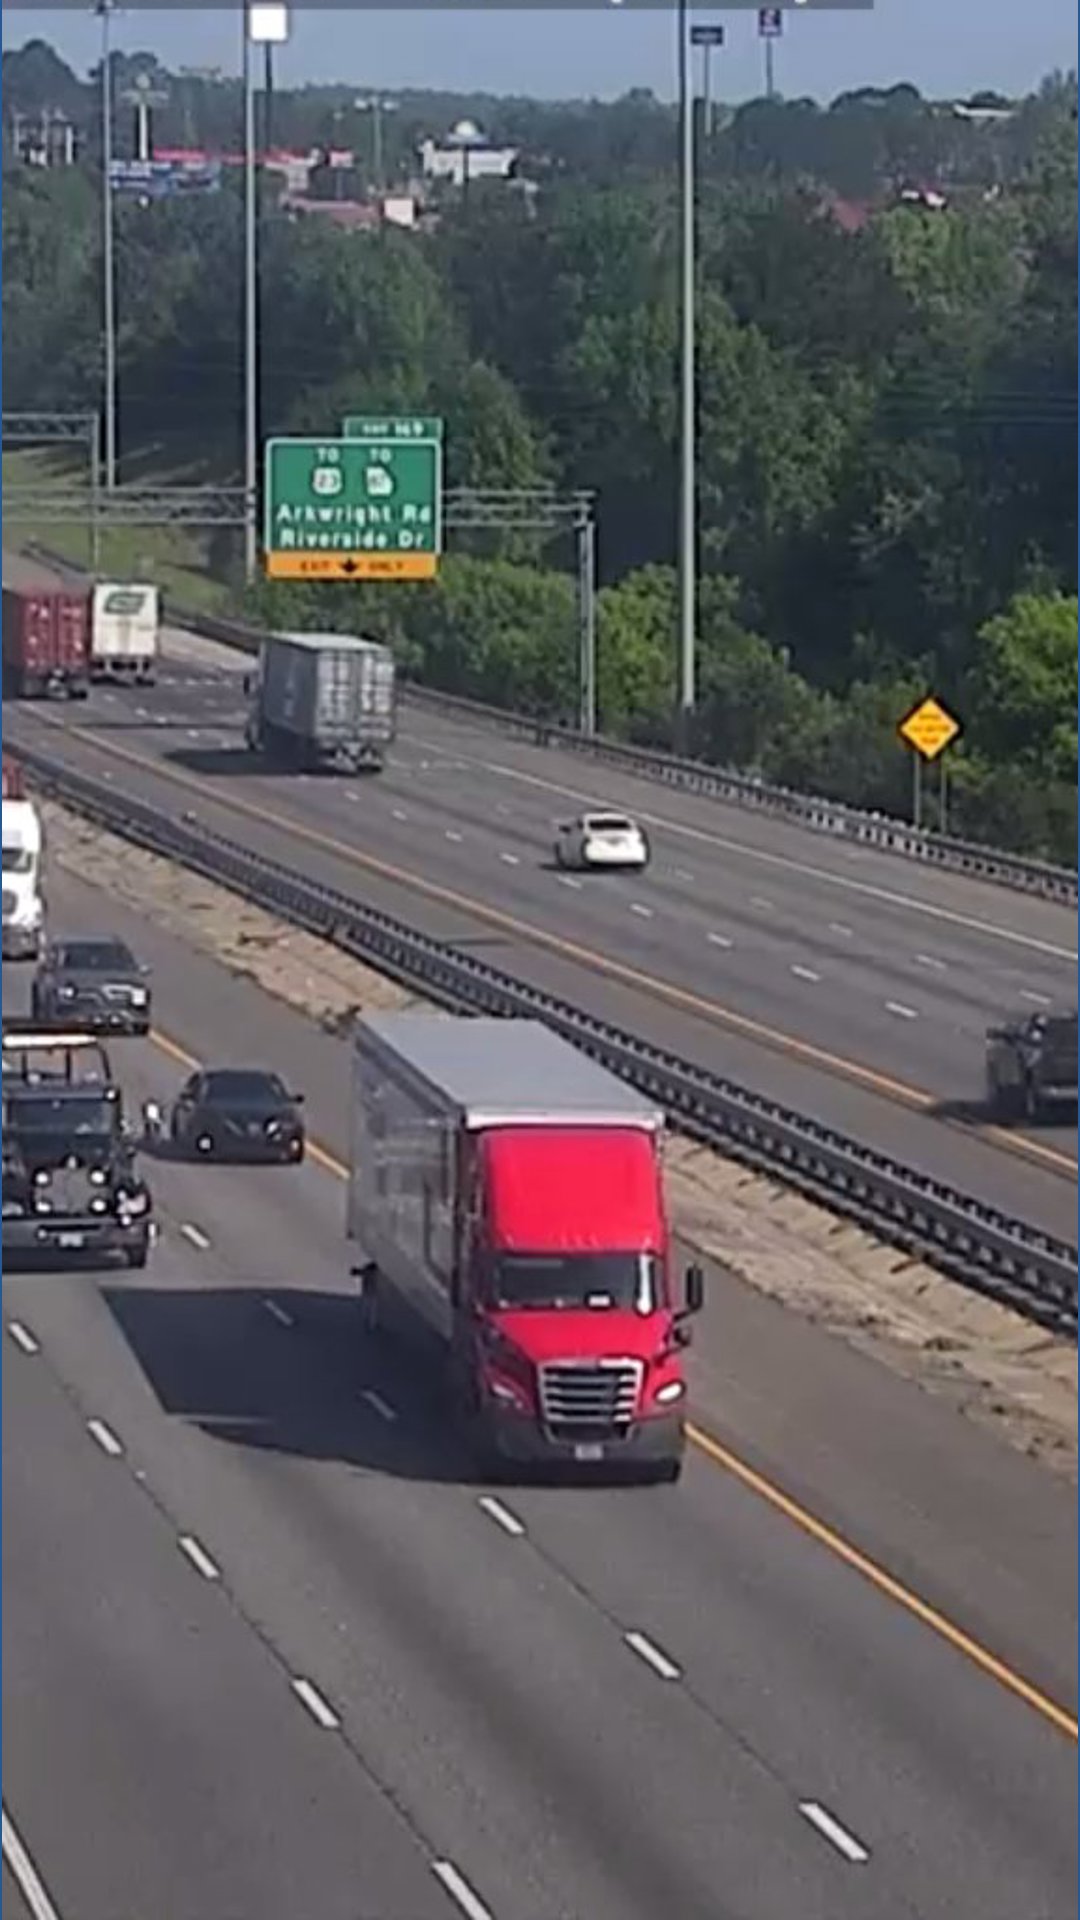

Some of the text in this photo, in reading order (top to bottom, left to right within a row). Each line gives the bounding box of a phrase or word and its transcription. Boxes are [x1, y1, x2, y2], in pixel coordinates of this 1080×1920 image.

[317, 447, 340, 463] TO
[370, 447, 392, 463] TO
[277, 504, 431, 527] Arkwright Rd
[280, 529, 424, 548] Riverside Dr
